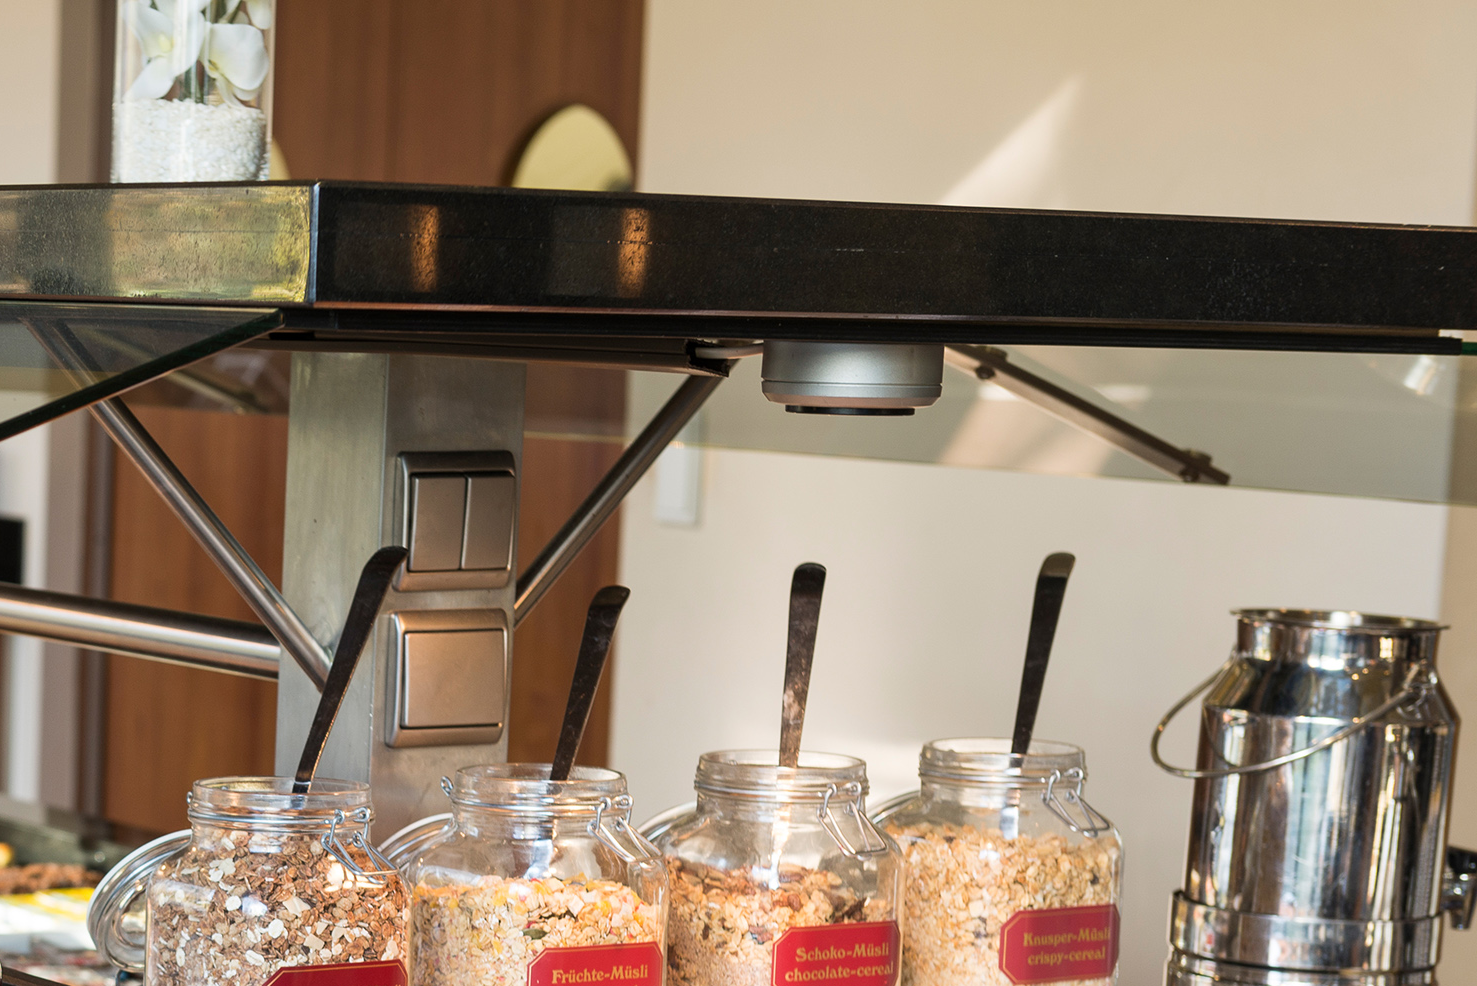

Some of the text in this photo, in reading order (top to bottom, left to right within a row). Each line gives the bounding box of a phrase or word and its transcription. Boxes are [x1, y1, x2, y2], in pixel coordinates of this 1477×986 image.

[1023, 926, 1111, 948] Knusper-Müsli
[795, 942, 890, 963] Schoko-Müsli
[1027, 945, 1107, 967] crispy-cereal
[551, 964, 649, 985] Früchte-Müsli
[784, 960, 894, 982] chocolate-cereal
